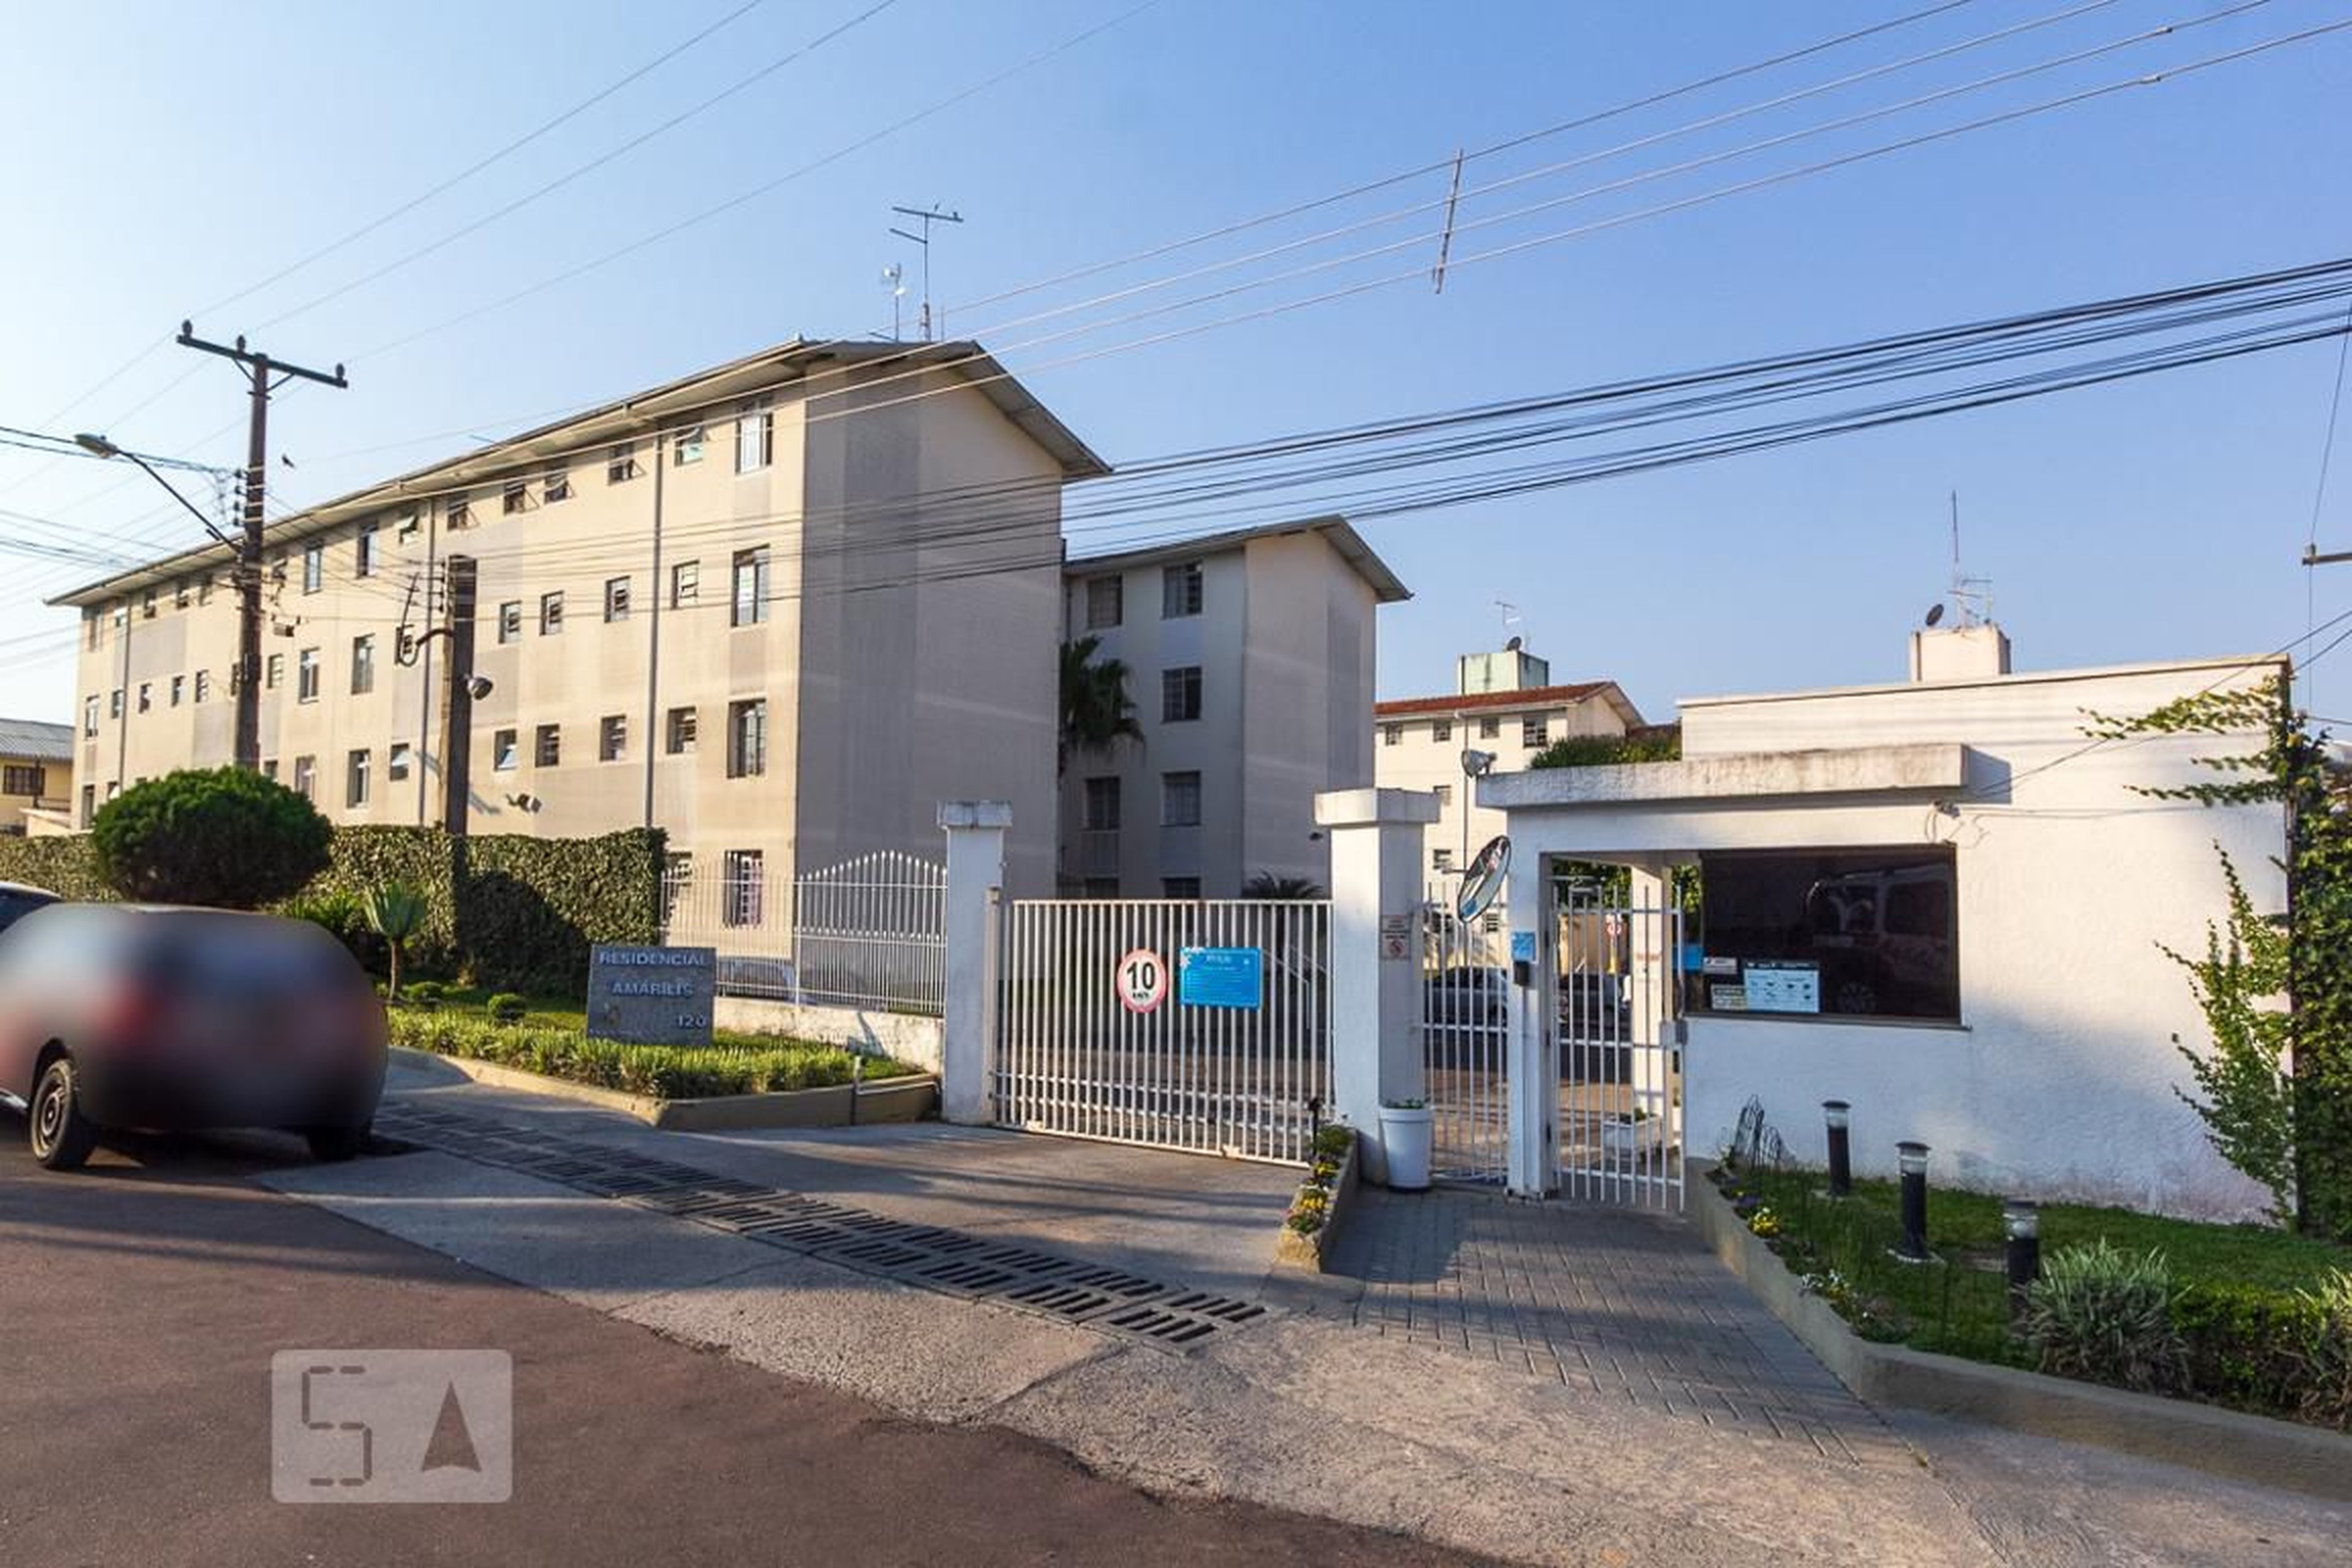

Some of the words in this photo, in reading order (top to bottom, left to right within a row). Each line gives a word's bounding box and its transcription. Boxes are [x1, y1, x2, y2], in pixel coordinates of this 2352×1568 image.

[600, 951, 706, 965] RESIDENCIAL
[1126, 961, 1155, 990] 10
[678, 1013, 707, 1027] 120
